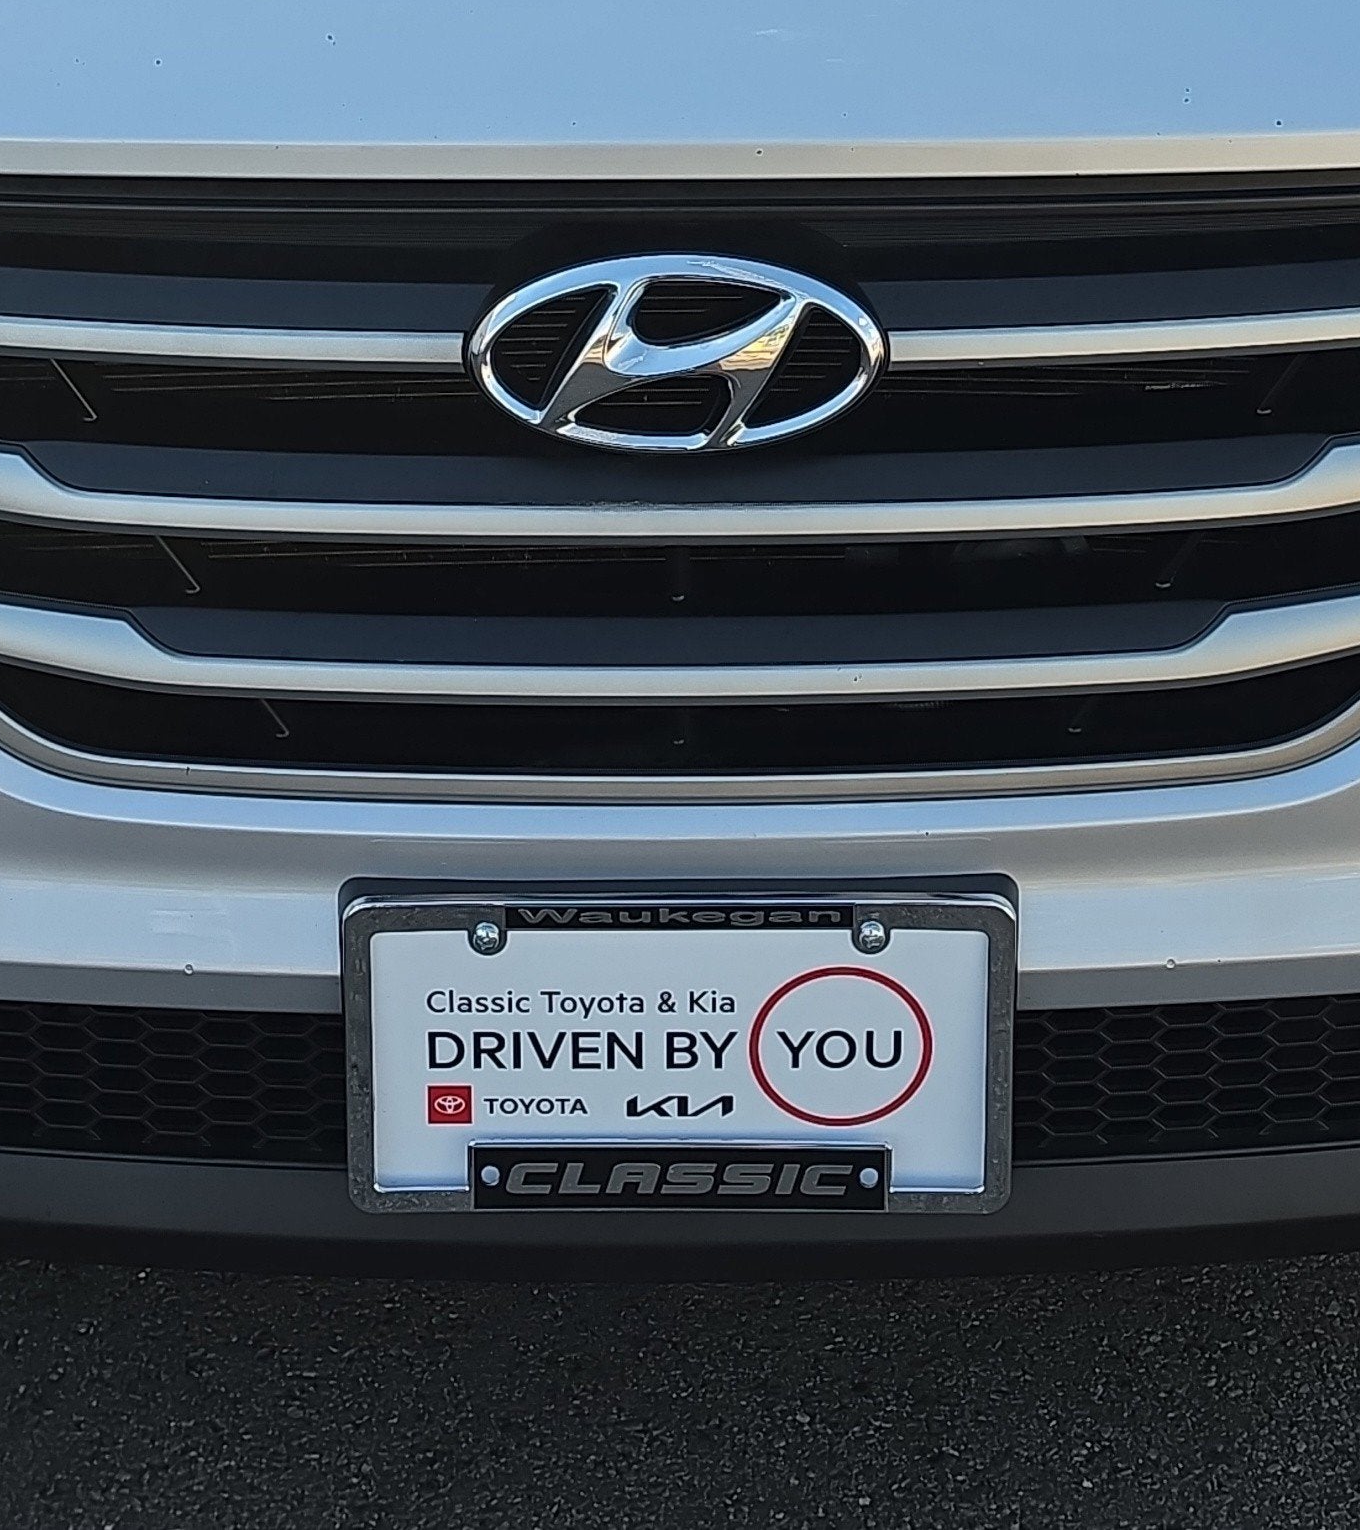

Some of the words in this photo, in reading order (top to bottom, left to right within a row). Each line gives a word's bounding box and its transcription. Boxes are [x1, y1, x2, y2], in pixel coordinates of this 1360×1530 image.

[517, 908, 841, 927] Waukegan
[426, 990, 531, 1014] Classic
[540, 990, 645, 1019] Toyota
[657, 991, 677, 1014] &
[688, 989, 737, 1014] Kia
[427, 1030, 643, 1070] DRIVEN
[665, 1031, 739, 1070] BY
[776, 1029, 903, 1069] YOU
[483, 1097, 588, 1115] TOYOTA
[505, 1162, 853, 1195] CLASSIC
